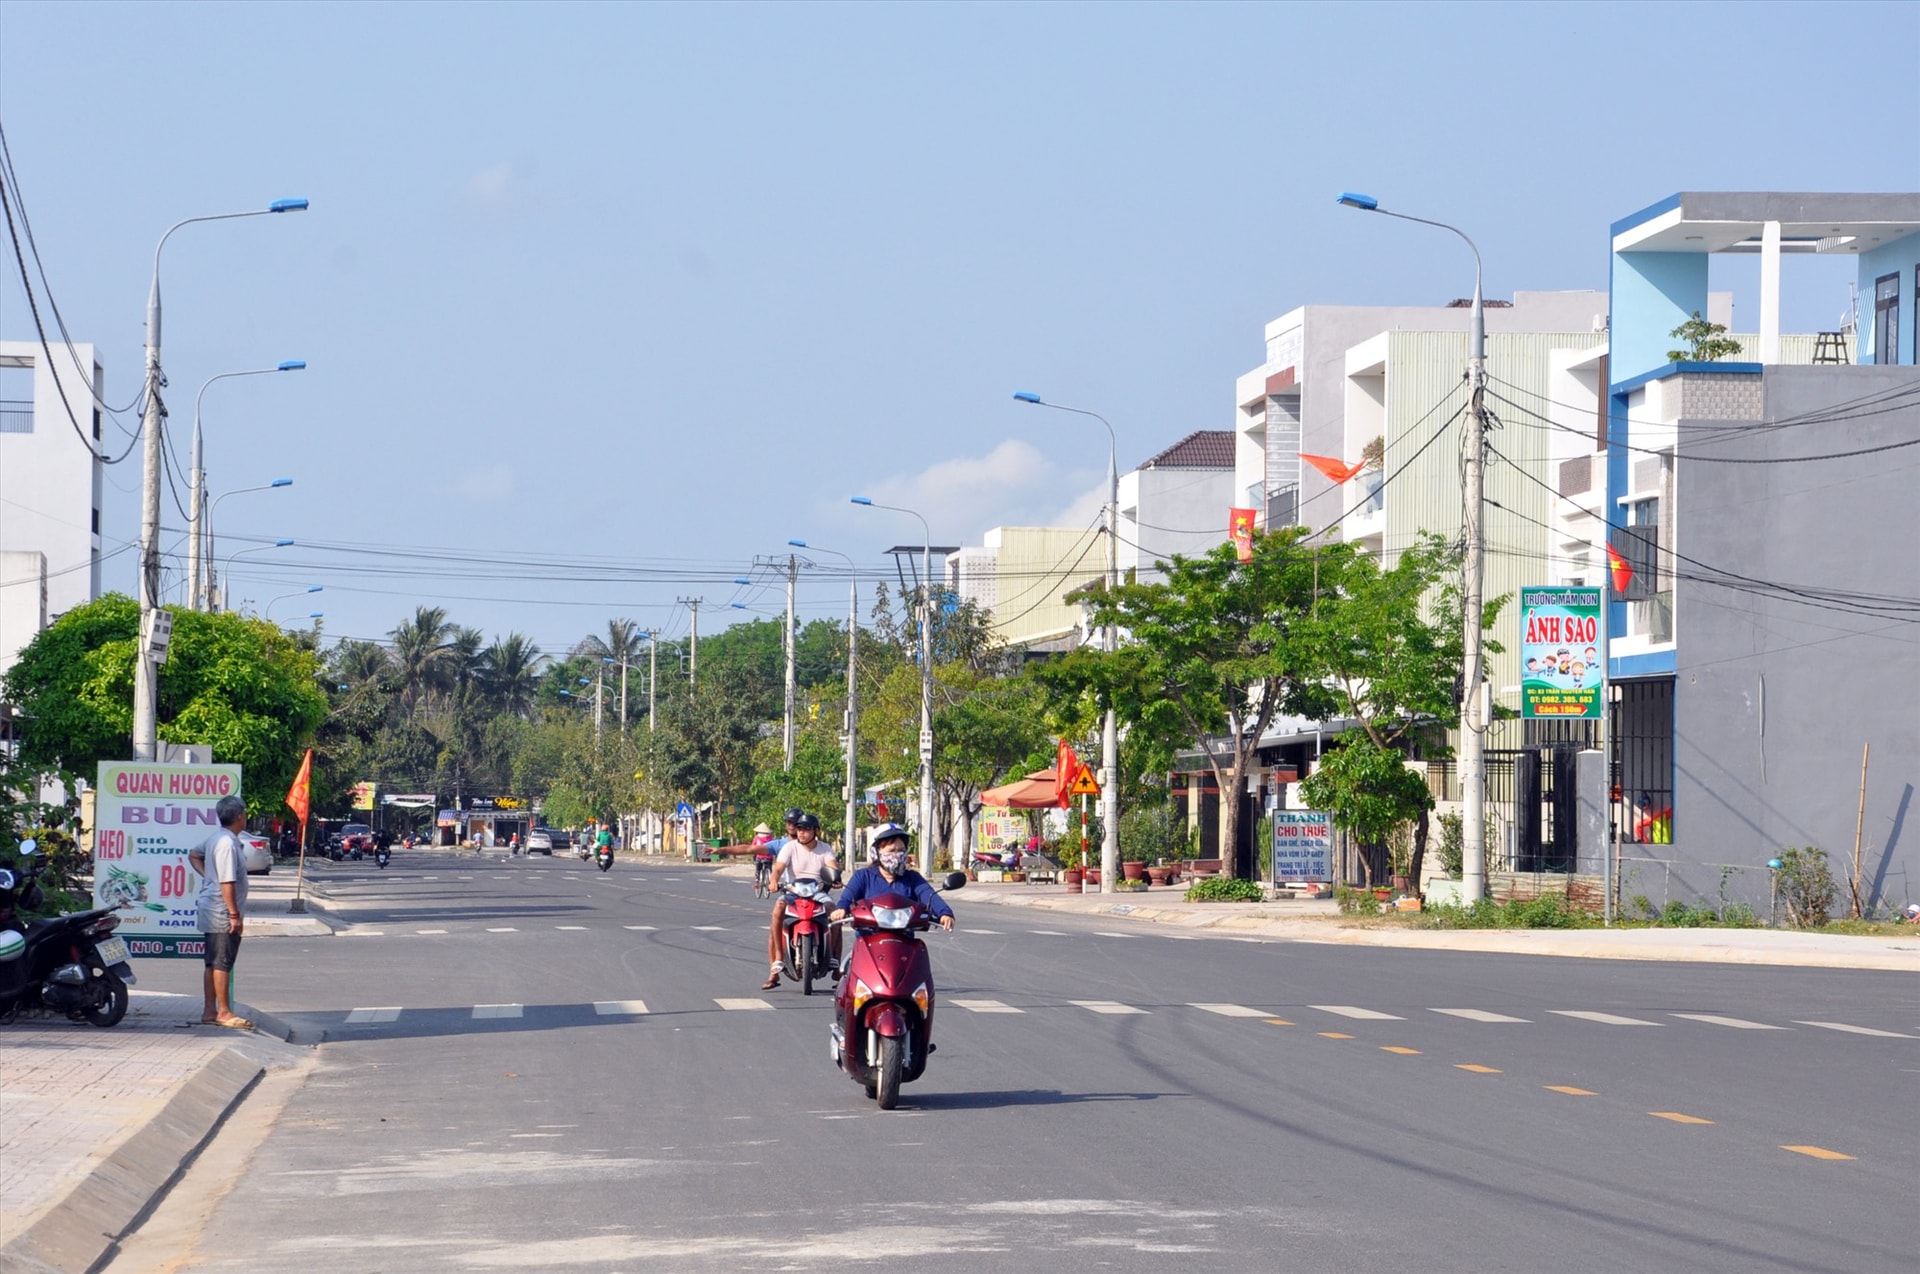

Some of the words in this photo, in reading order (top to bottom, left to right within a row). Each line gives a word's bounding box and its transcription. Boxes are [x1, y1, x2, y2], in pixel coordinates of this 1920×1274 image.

[1581, 594, 1597, 605] NON
[1525, 609, 1561, 643] ÁNH
[1565, 616, 1597, 643] SAO
[121, 803, 217, 826] BÚN
[1277, 826, 1298, 837] CHO
[98, 830, 124, 859] HEO
[137, 847, 188, 855] XƯƠN
[160, 857, 186, 896] BÒ
[131, 942, 163, 954] N10
